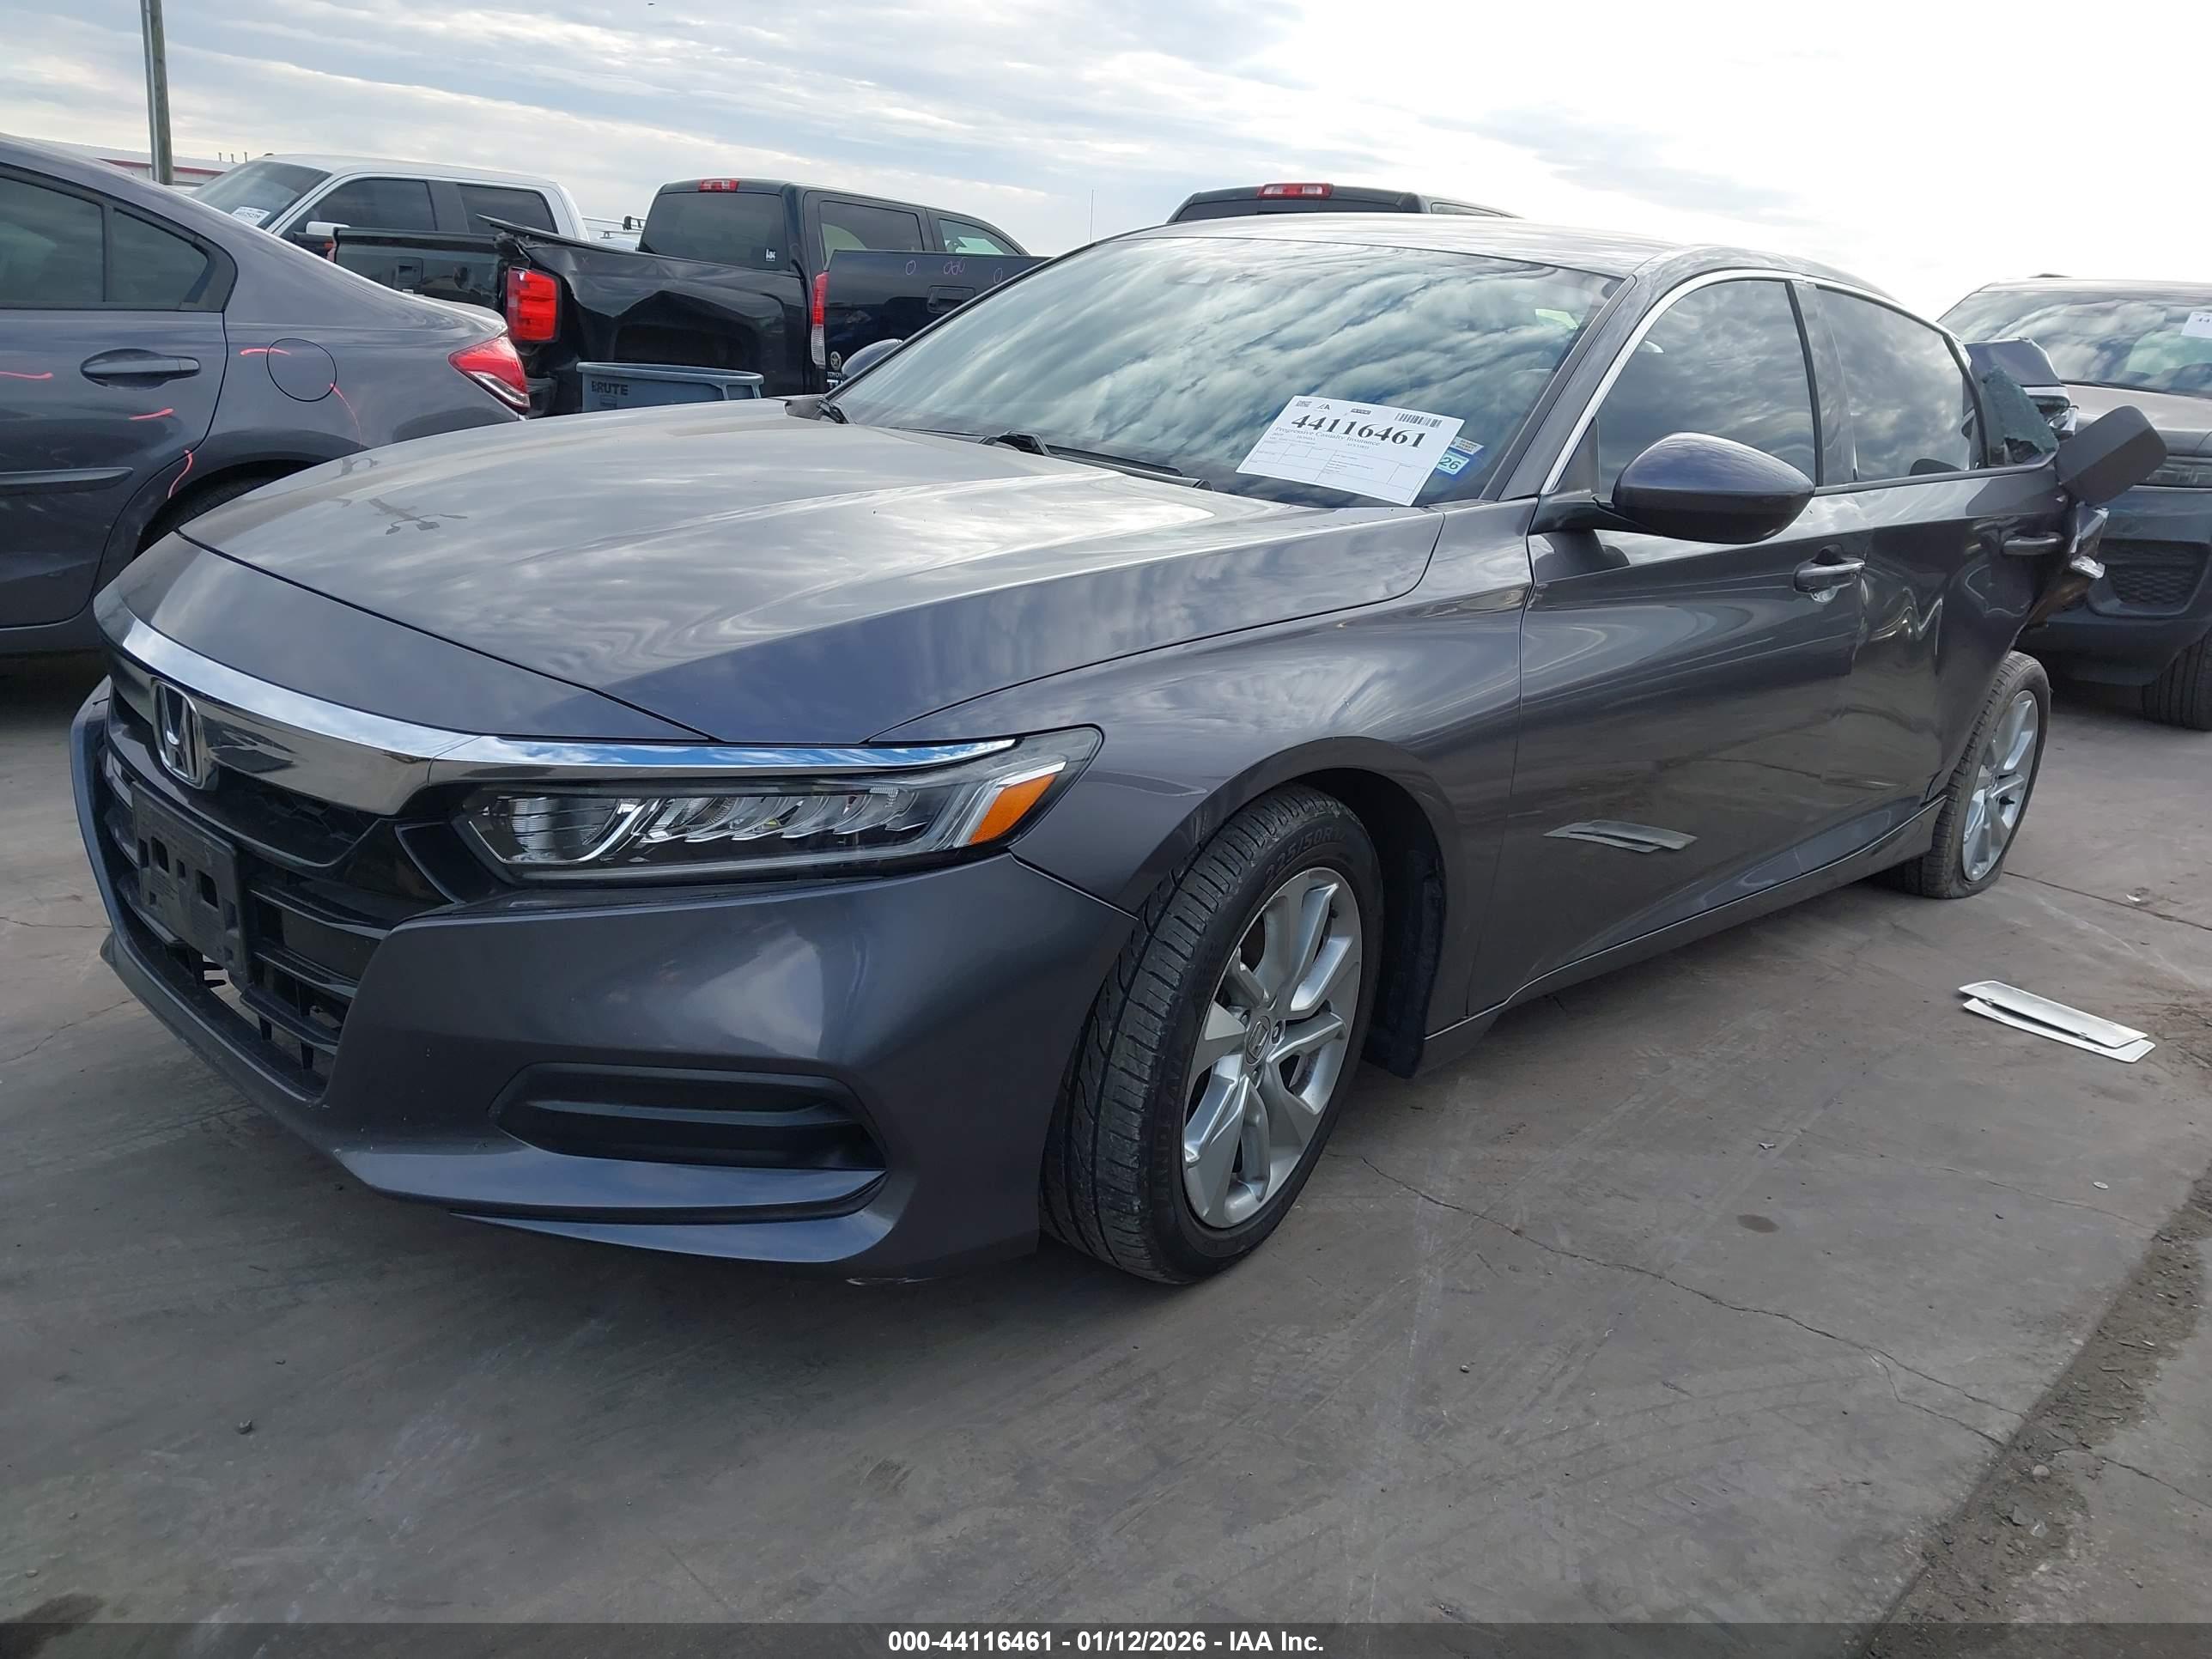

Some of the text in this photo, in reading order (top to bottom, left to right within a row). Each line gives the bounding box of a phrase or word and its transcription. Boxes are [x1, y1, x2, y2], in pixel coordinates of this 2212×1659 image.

[592, 380, 629, 396] BRUTE
[1275, 426, 1315, 435] Progressive
[1316, 431, 1345, 441] Casualty
[1346, 434, 1381, 447] Insurance
[1291, 415, 1426, 448] 44116461
[1438, 457, 1462, 470] 26
